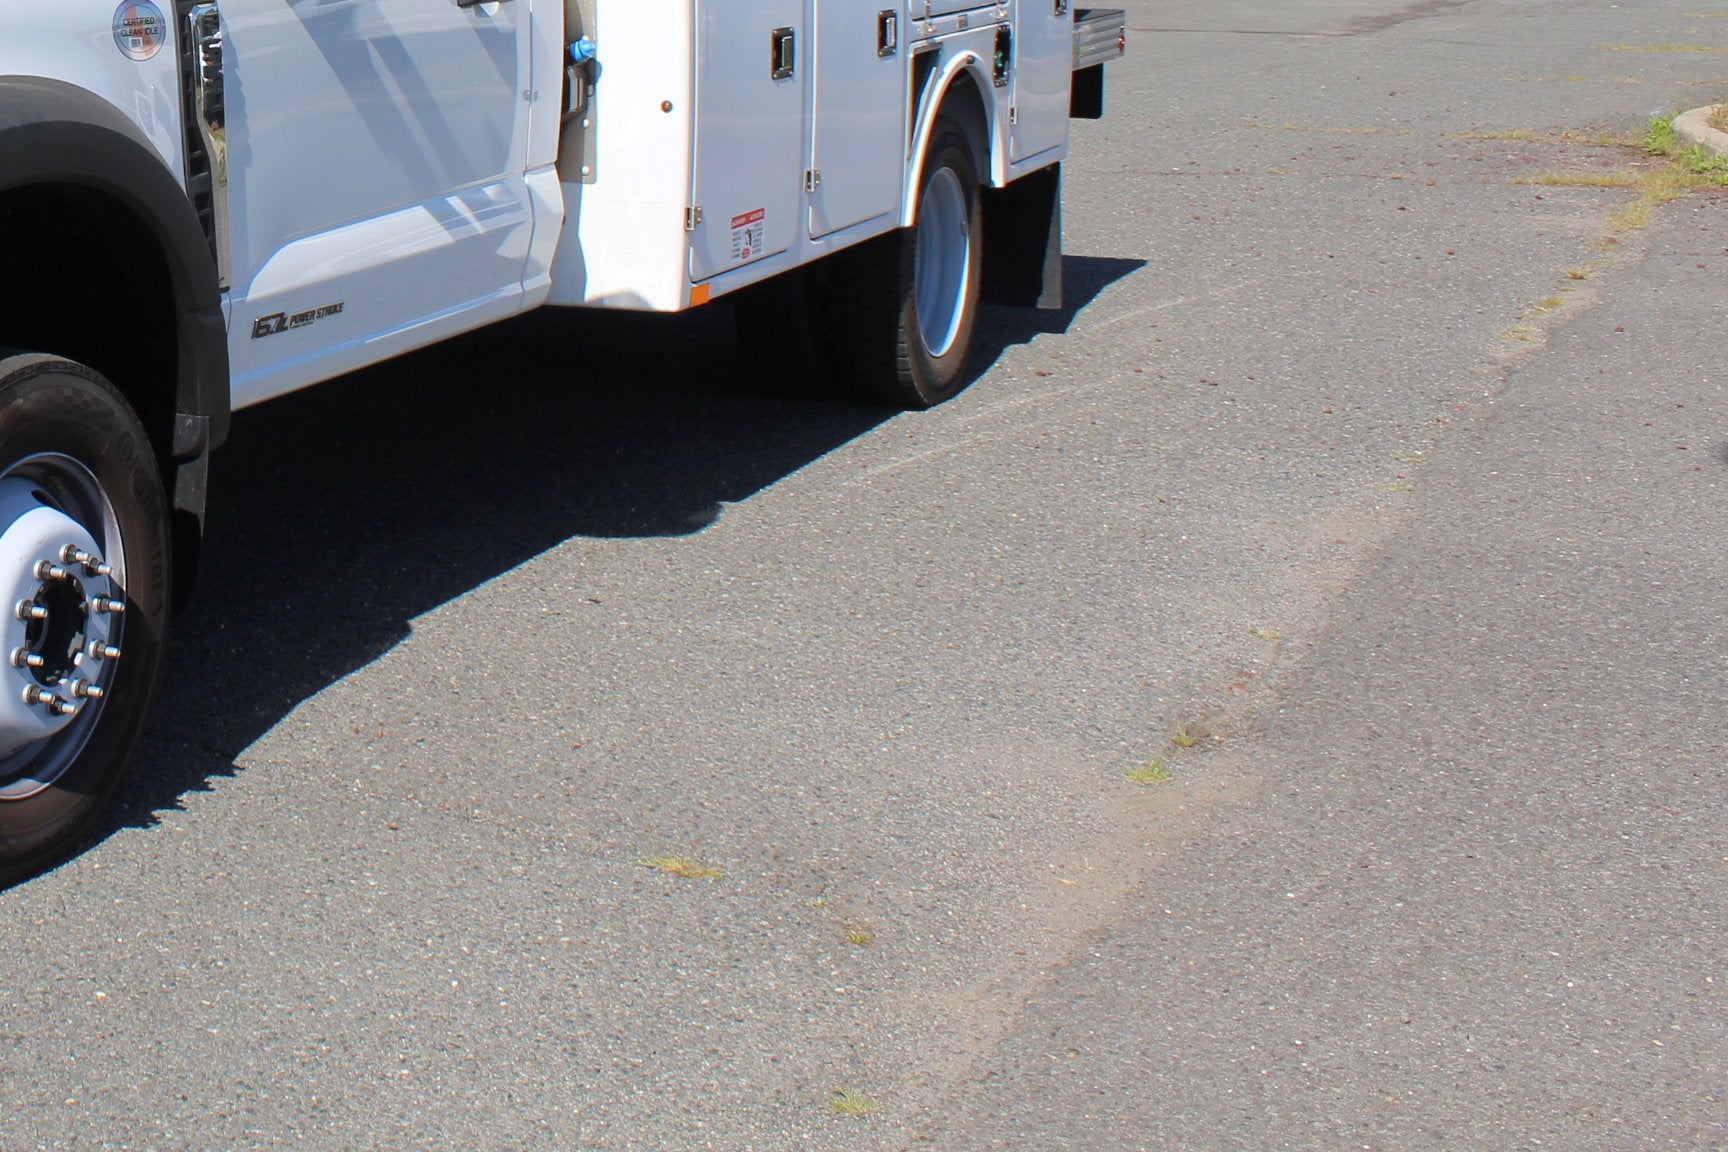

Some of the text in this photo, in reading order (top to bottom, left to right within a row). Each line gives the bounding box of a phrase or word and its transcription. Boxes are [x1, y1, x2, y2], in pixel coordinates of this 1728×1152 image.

[123, 16, 155, 27] CERTIFIED
[120, 28, 143, 37] CLEAN
[289, 309, 315, 326] POWER
[315, 301, 344, 319] STROKE
